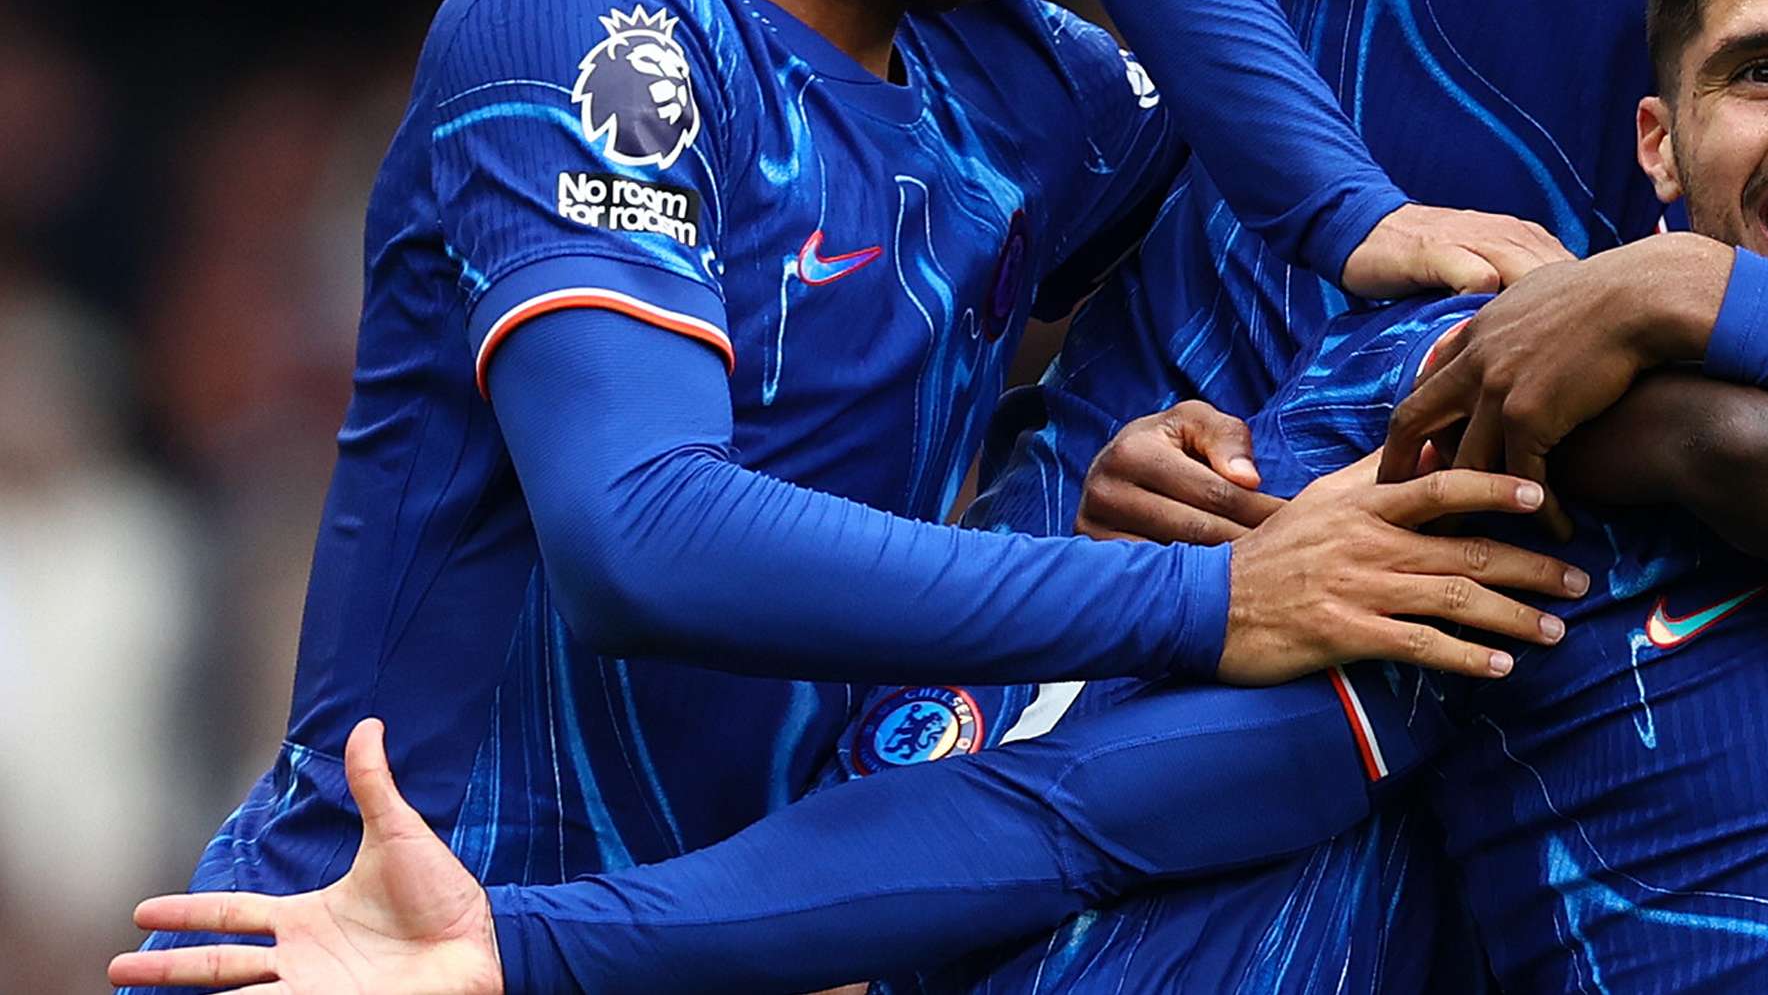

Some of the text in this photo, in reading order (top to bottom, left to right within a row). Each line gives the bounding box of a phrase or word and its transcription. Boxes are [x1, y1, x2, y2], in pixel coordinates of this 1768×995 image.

[558, 172, 688, 219] No room
[903, 686, 974, 725] CHELSEA
